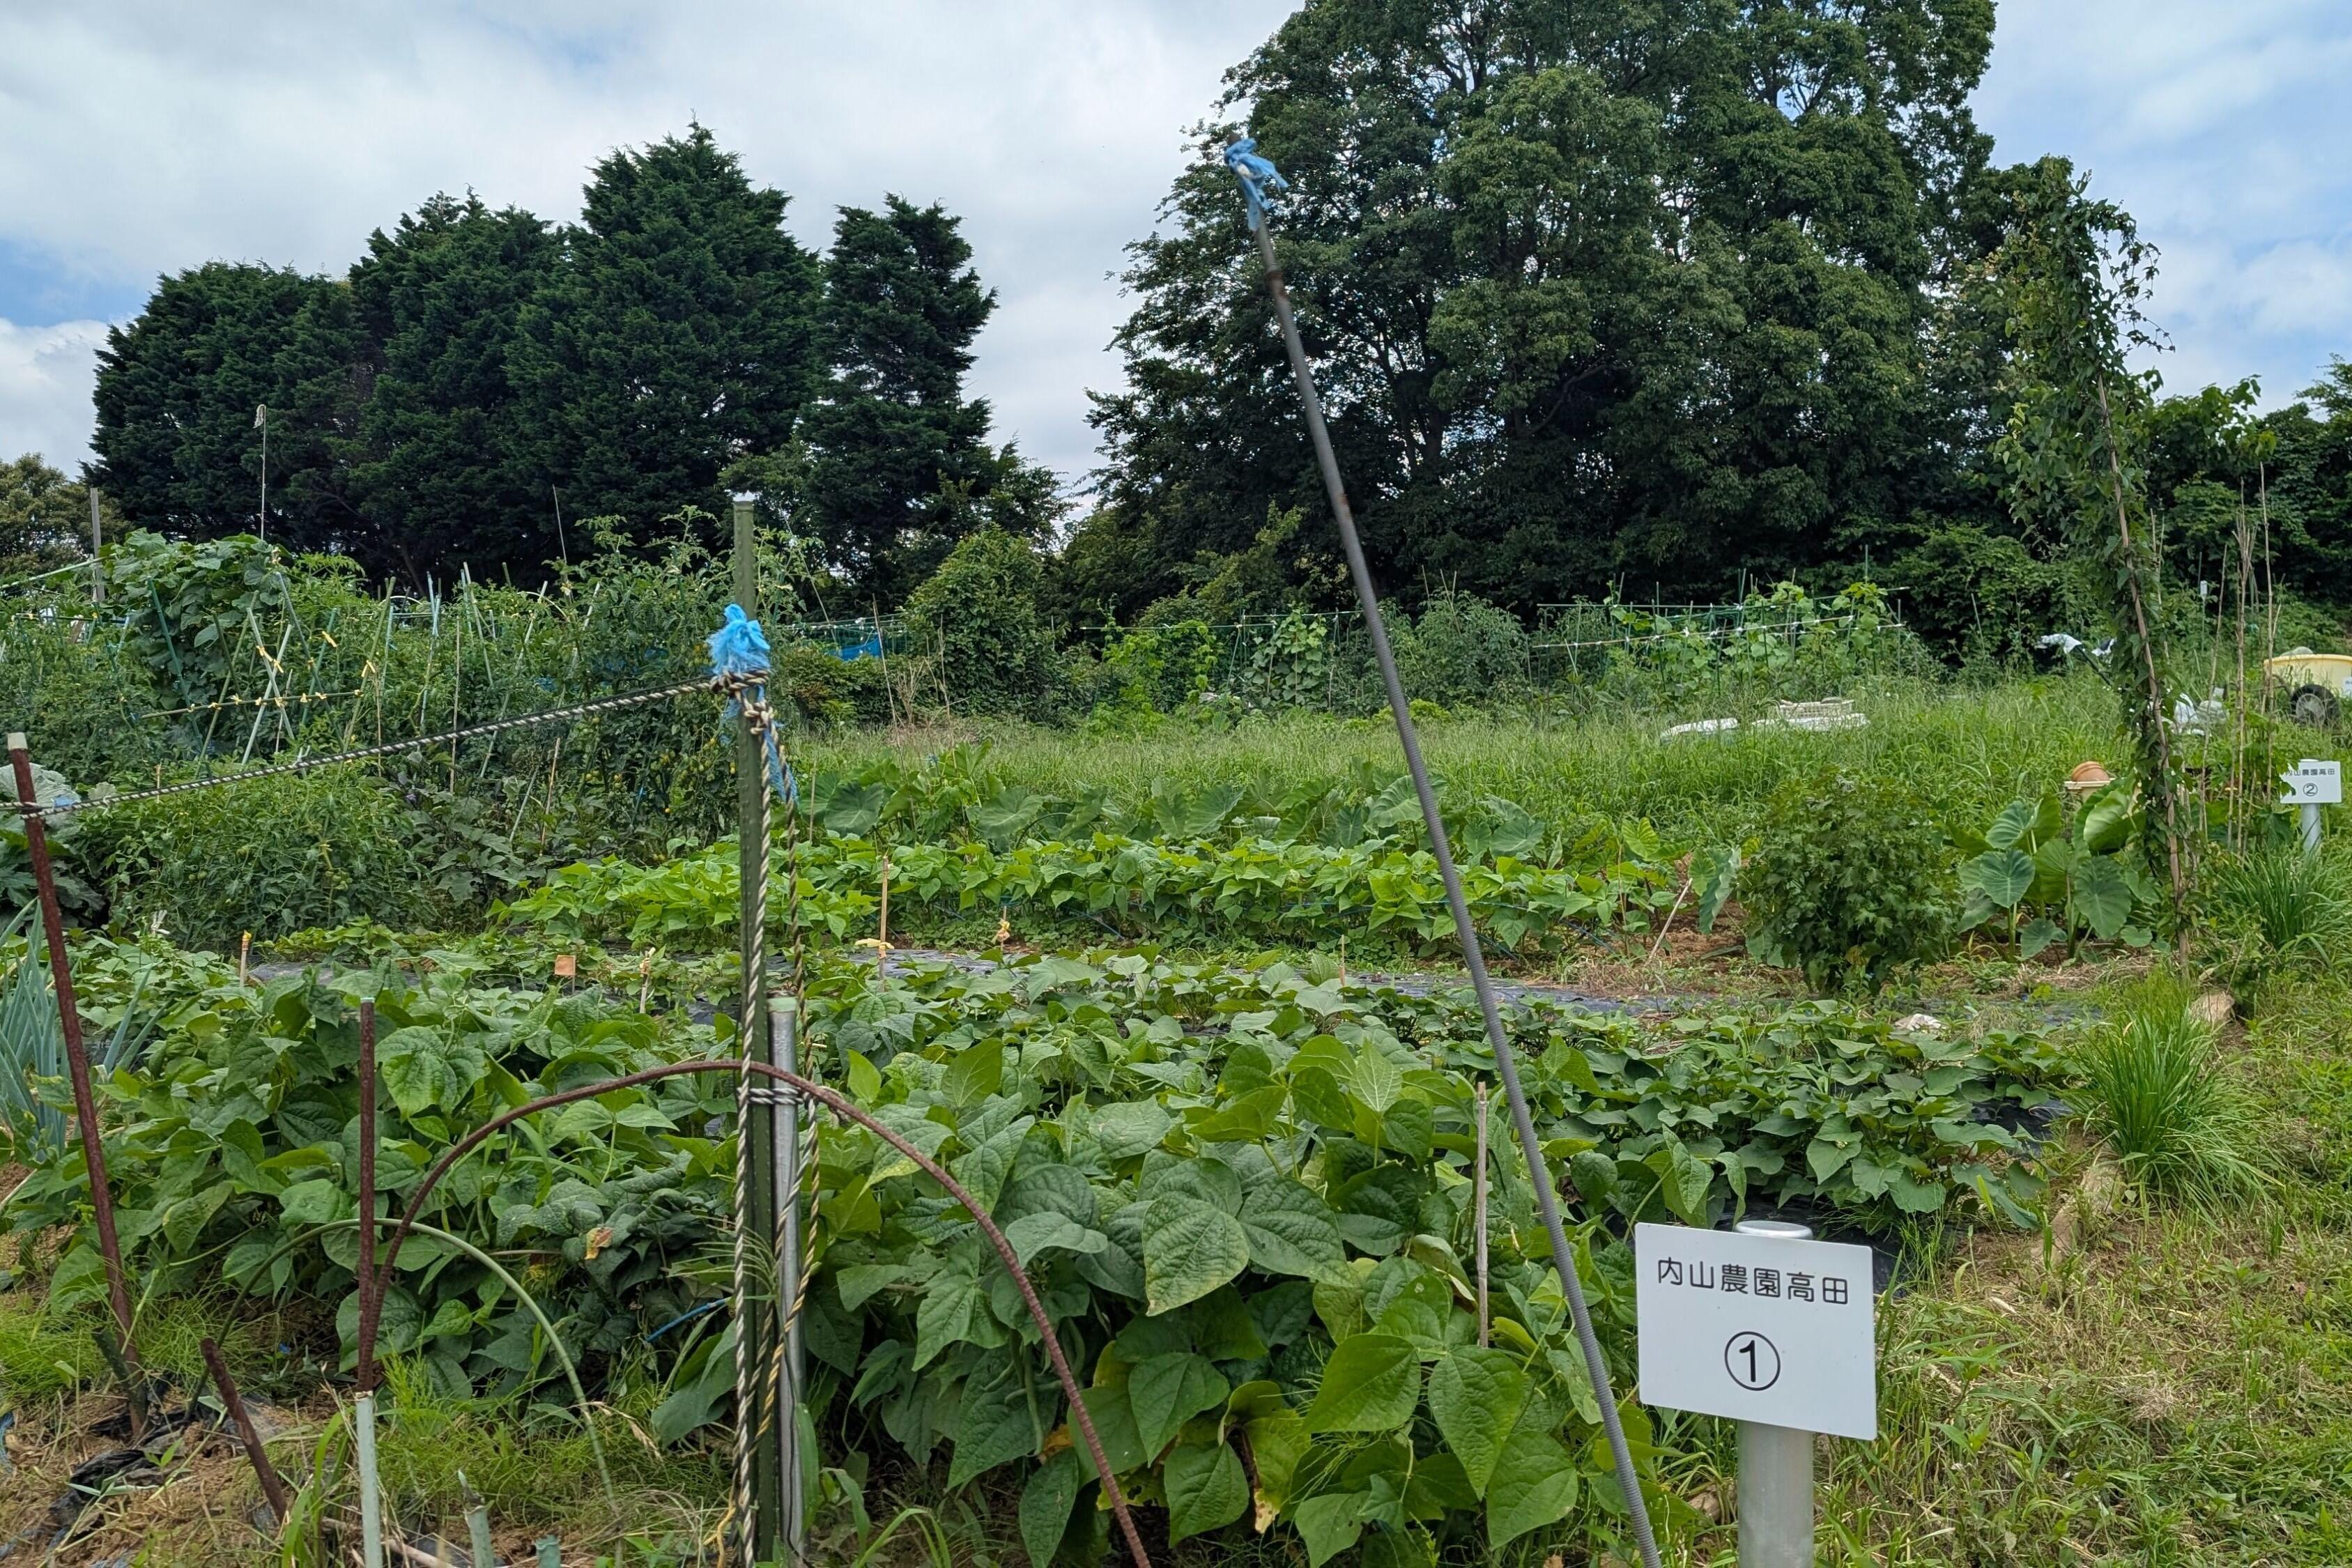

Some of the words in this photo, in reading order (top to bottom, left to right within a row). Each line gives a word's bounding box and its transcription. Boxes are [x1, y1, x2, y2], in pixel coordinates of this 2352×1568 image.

[1657, 1256, 1849, 1305] 内山農園高田
